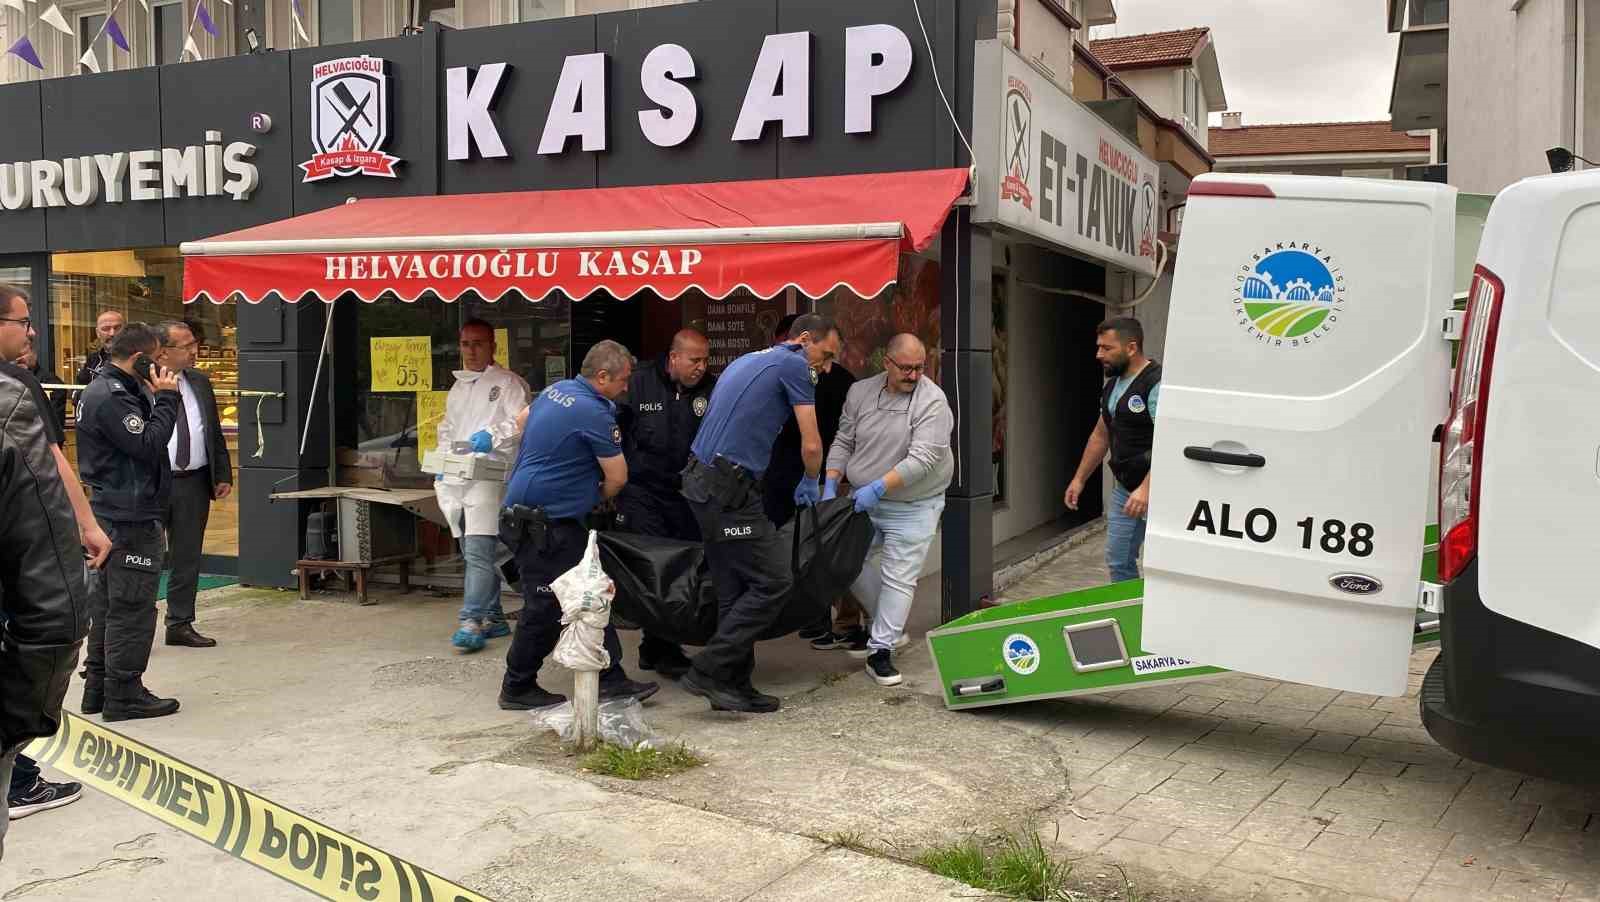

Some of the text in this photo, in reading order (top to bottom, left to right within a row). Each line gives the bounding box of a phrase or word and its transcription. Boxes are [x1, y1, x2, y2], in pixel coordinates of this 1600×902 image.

[314, 57, 381, 79] HELVACIOĞLU
[446, 23, 913, 161] KASAP
[0, 130, 258, 210] URUYEMİŞ
[320, 157, 344, 167] Kasap
[1039, 129, 1137, 257] ET-TAVUK
[324, 248, 703, 280] HELVACIOĞLU KASAP
[1252, 241, 1332, 264] SAKARYA
[1186, 500, 1375, 558] ALO 188
[1340, 580, 1370, 591] Ford
[1135, 657, 1177, 671] SAKARYA
